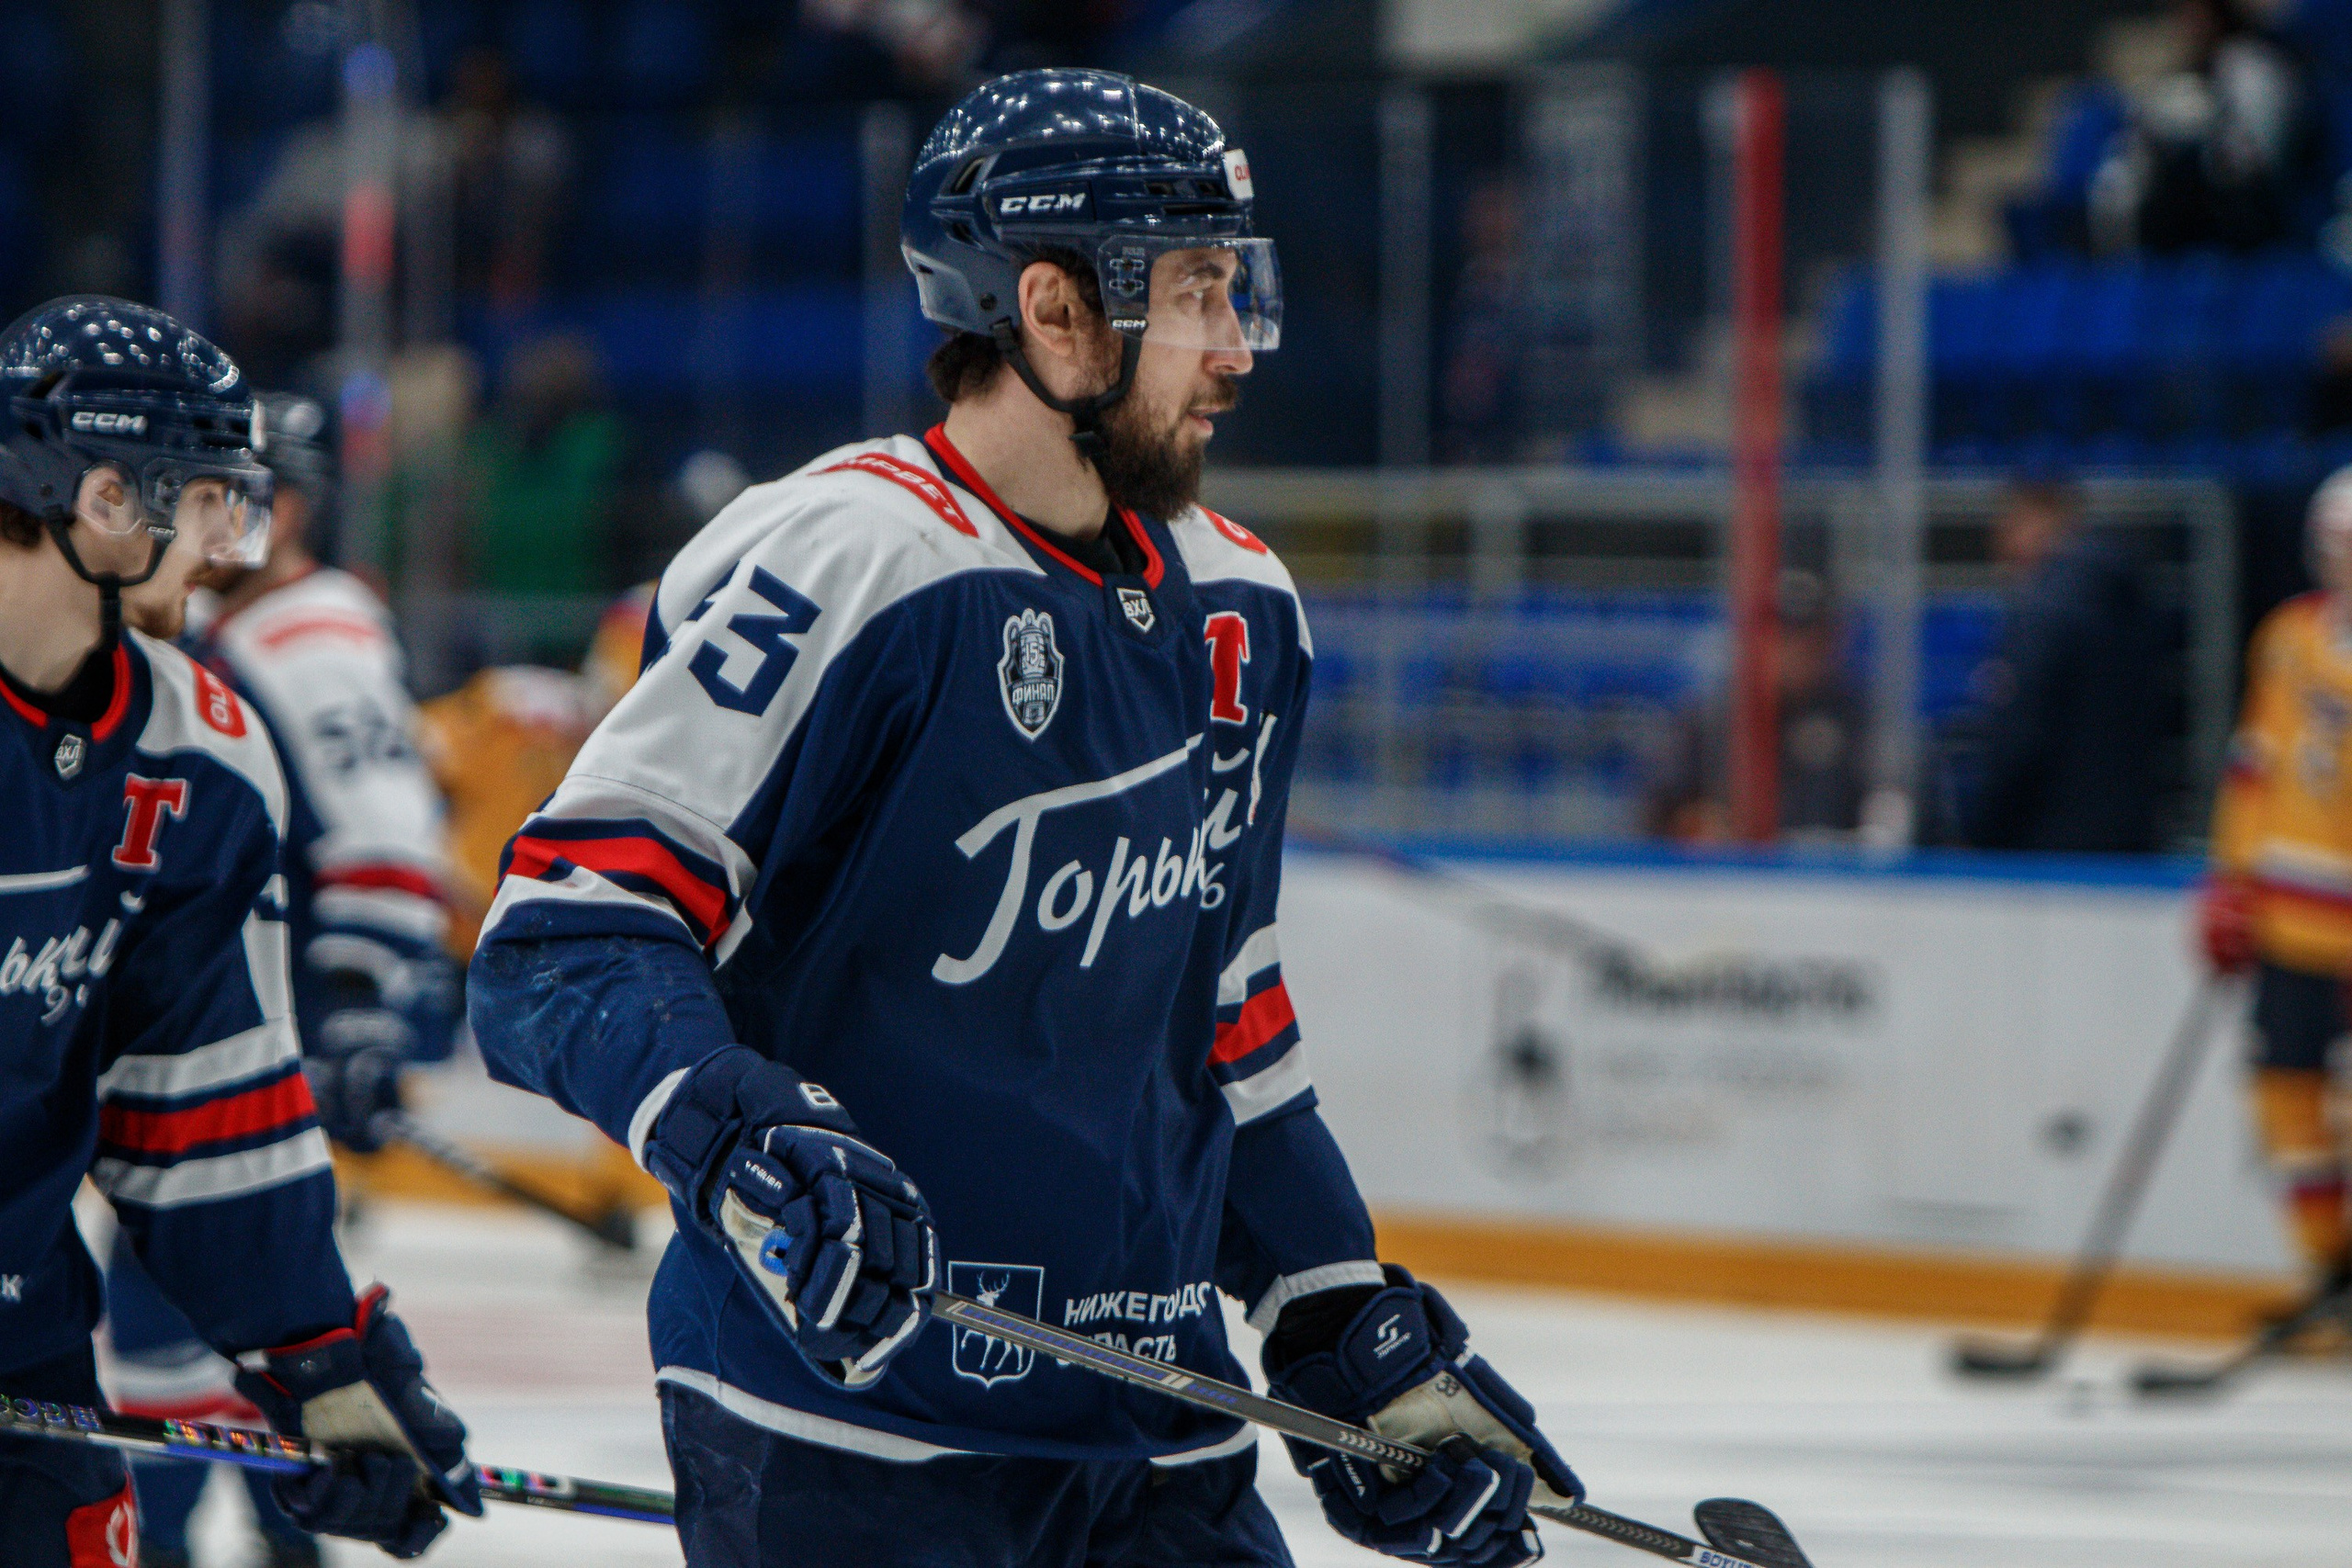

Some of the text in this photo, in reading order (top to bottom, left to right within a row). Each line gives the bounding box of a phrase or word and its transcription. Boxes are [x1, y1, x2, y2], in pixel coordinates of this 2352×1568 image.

[1001, 192, 1086, 214] CCM
[1113, 320, 1147, 328] CCM
[72, 412, 148, 435] CCM
